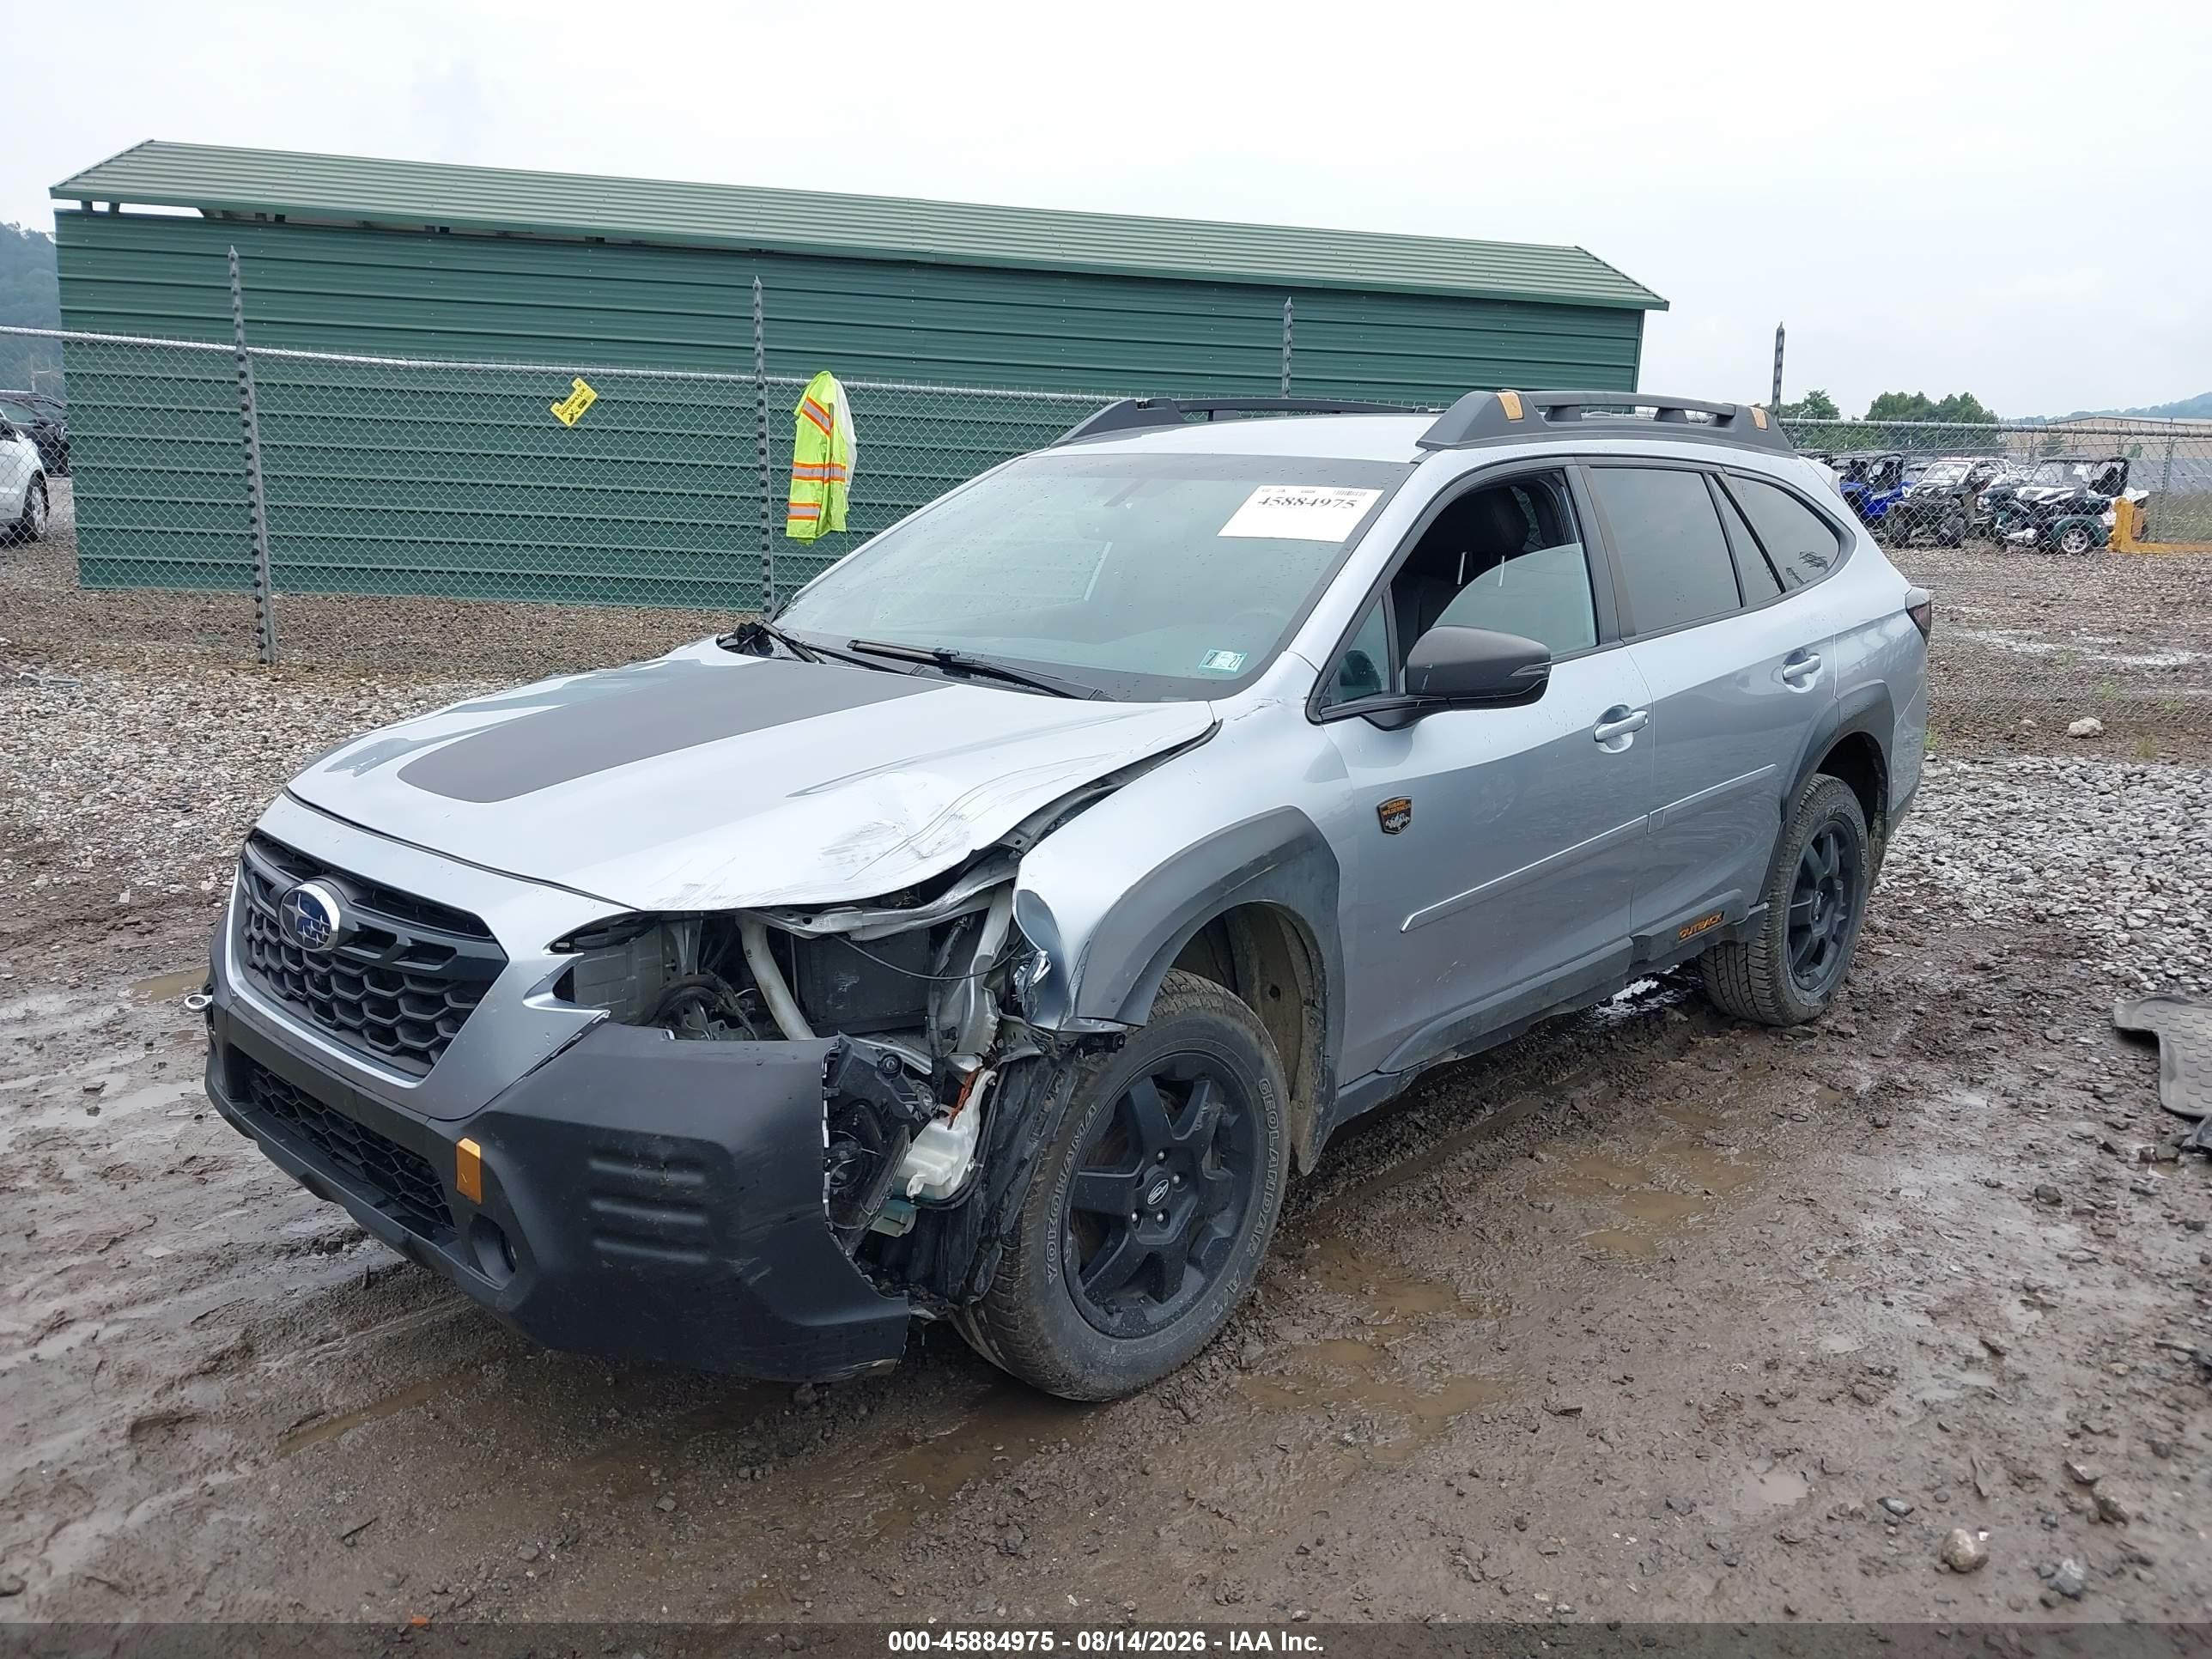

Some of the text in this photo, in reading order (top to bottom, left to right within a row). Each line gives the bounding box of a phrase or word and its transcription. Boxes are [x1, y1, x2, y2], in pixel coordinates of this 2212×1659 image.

[1257, 496, 1358, 509] 45884975
[1680, 912, 1723, 939] OUTBACK
[1046, 1103, 1097, 1285] YOKOHAMA
[1209, 1078, 1279, 1324] GEOLANDAR A/T
